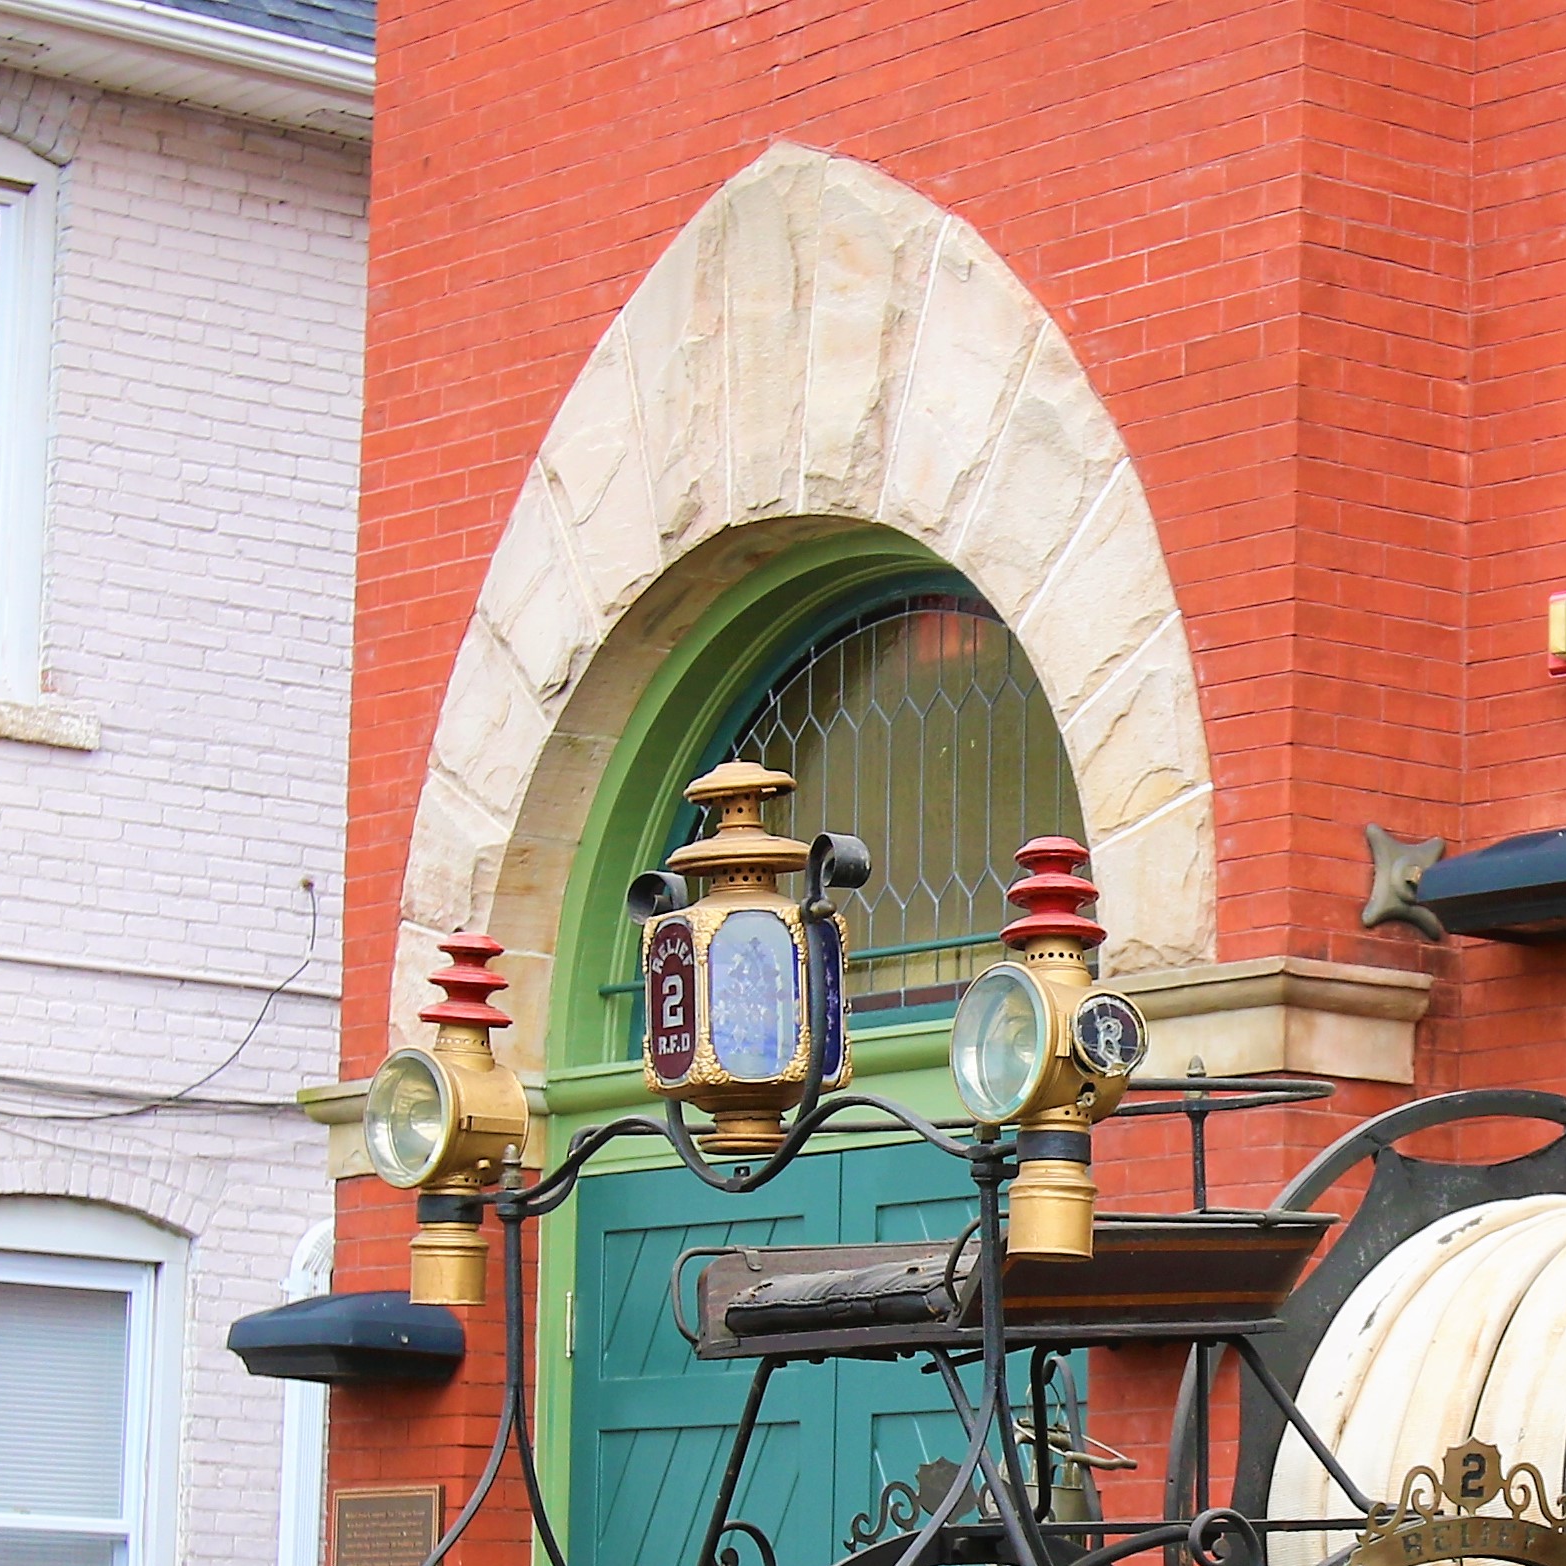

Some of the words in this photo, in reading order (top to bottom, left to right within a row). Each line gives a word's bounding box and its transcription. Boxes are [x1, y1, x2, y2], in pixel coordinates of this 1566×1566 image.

[651, 937, 693, 975] RELIEF
[661, 974, 685, 1029] 2
[657, 1031, 691, 1055] R.F.D
[1460, 1453, 1487, 1498] 2
[1401, 1521, 1542, 1560] RELIEF
